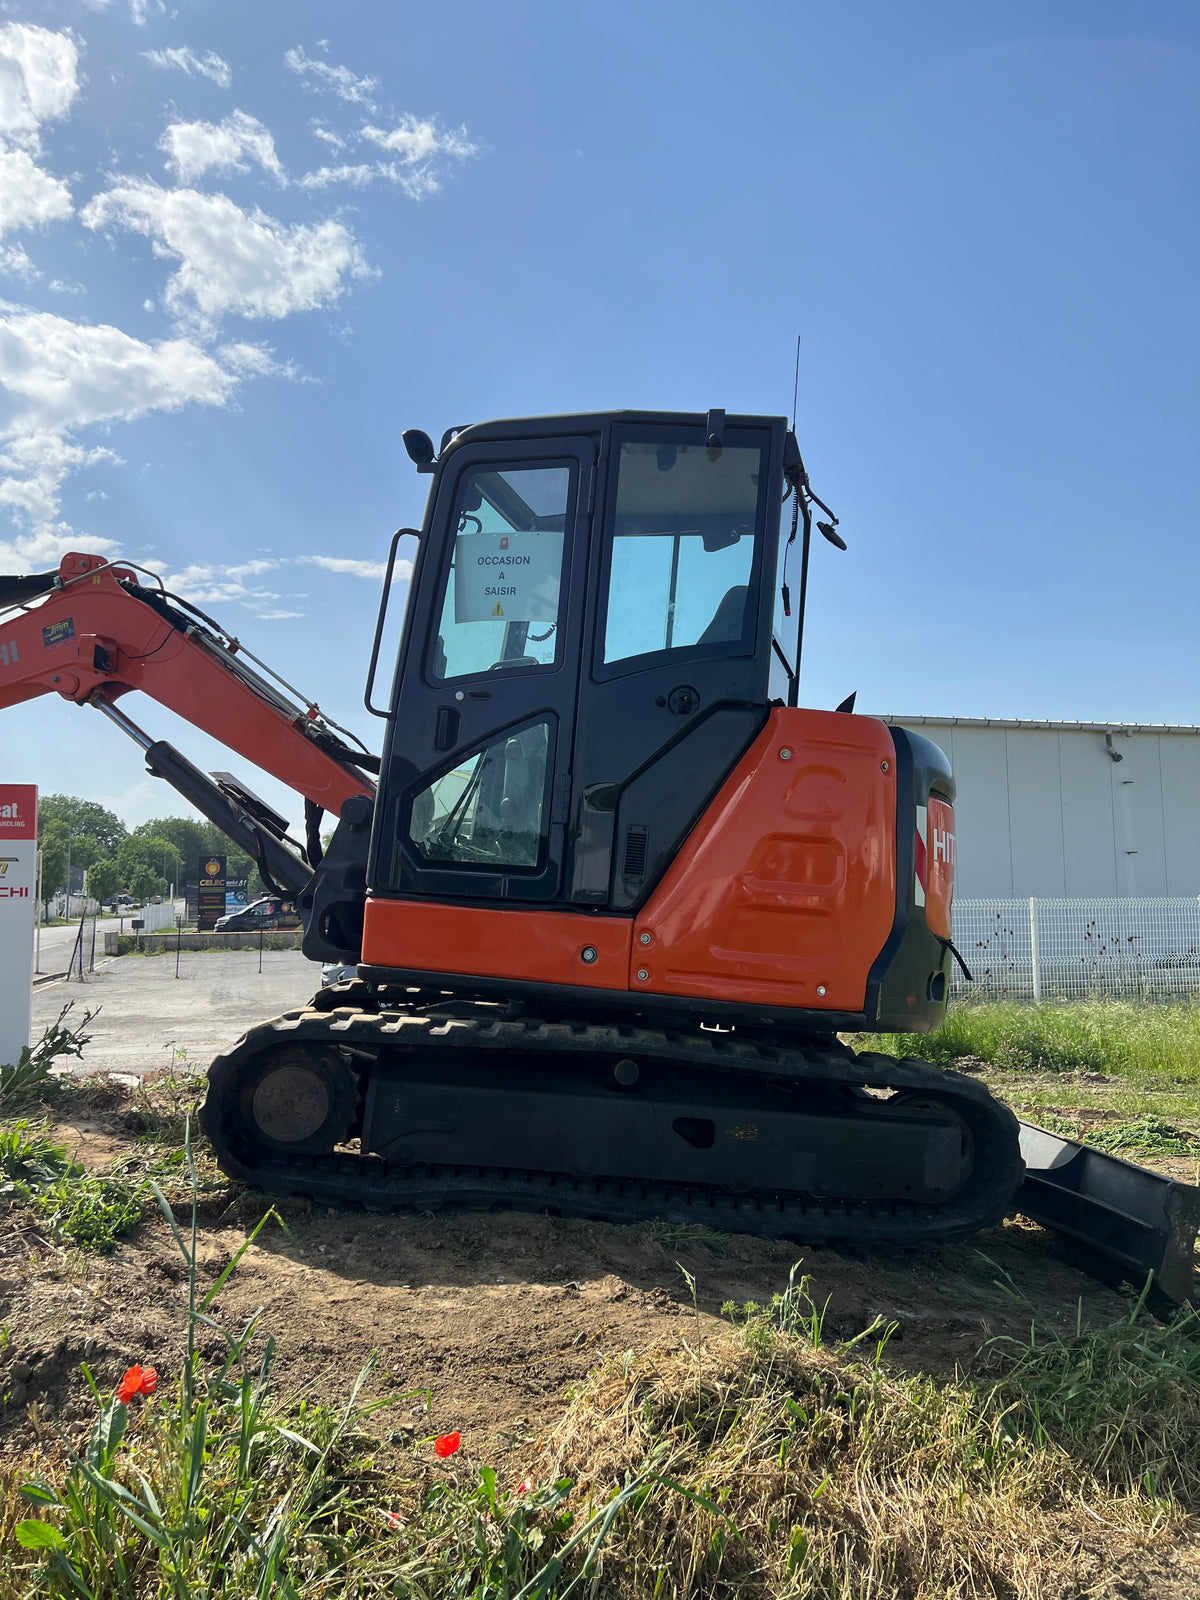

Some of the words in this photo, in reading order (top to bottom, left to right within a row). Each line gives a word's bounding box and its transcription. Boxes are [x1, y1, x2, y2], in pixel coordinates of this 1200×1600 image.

[477, 556, 530, 566] OCCASION
[498, 571, 505, 580] A
[484, 586, 517, 596] SAISIR
[200, 879, 225, 887] CELEC
